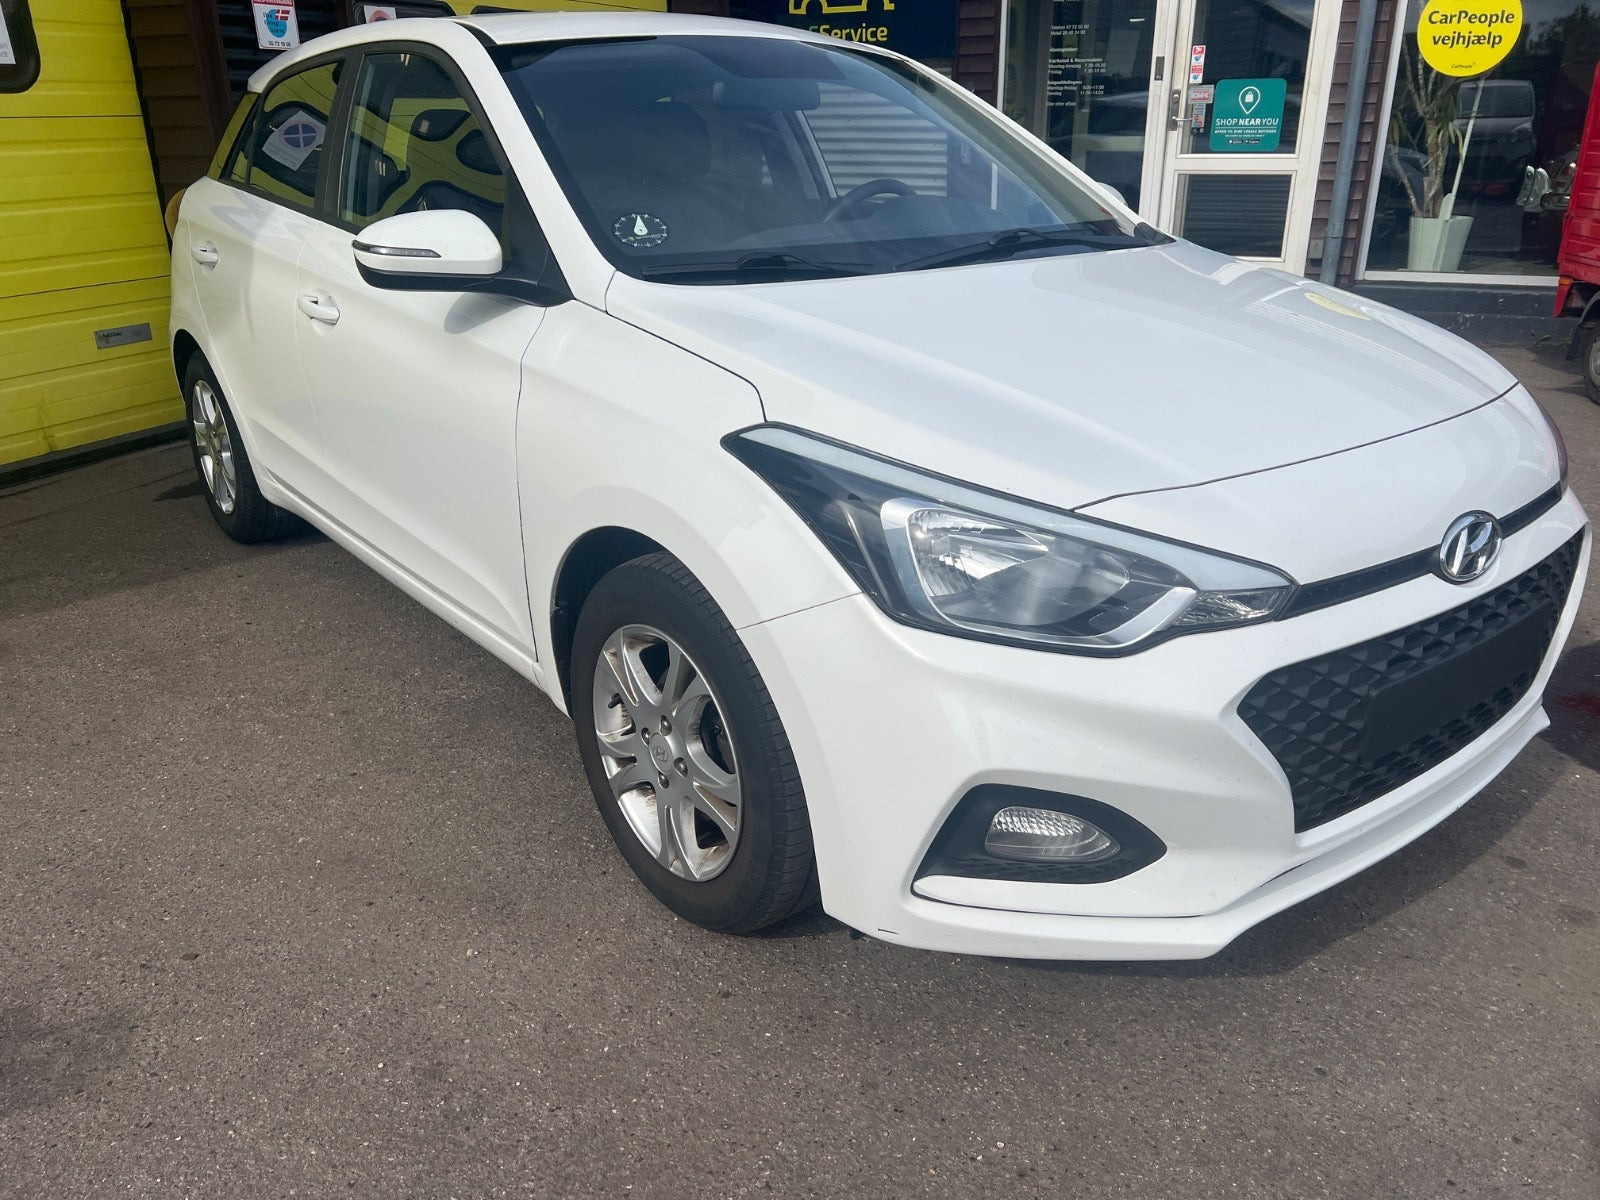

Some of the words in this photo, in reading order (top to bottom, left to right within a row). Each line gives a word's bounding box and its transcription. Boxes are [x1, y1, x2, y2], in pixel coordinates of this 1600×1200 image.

[1428, 10, 1515, 27] CarPeople
[1432, 31, 1503, 48] vejhjælp
[1215, 118, 1238, 126] SHOP
[1238, 118, 1261, 126] NEAR
